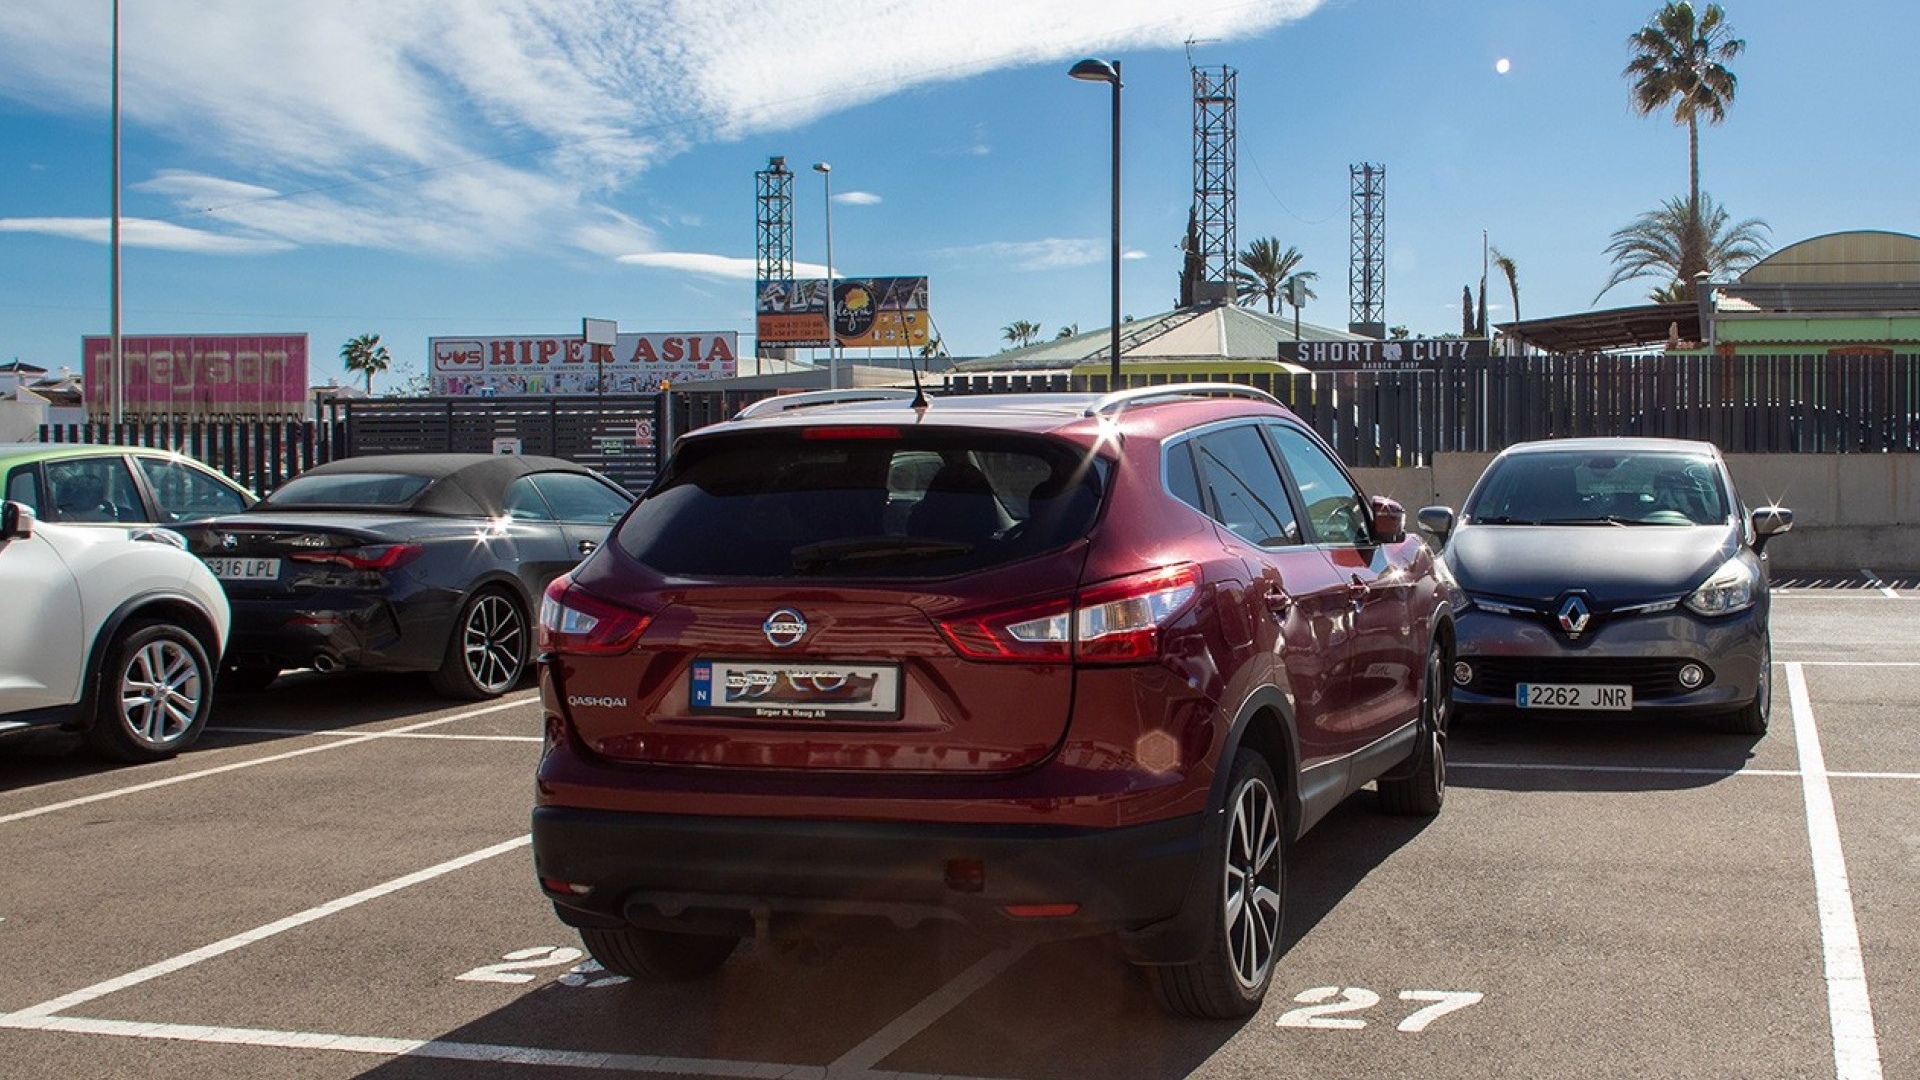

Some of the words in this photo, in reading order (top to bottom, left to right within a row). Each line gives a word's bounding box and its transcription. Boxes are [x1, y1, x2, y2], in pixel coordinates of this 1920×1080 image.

[489, 338, 615, 365] HIPER
[630, 336, 734, 363] ASIA
[1298, 342, 1374, 362] SHORT
[95, 350, 287, 396] preyser
[246, 561, 274, 577] LPL
[568, 695, 627, 708] QASHQAI
[697, 690, 707, 701] N
[1531, 686, 1580, 706] 2262
[1591, 688, 1627, 707] JNR
[755, 708, 781, 718] Birger
[1275, 986, 1484, 1032] 27
